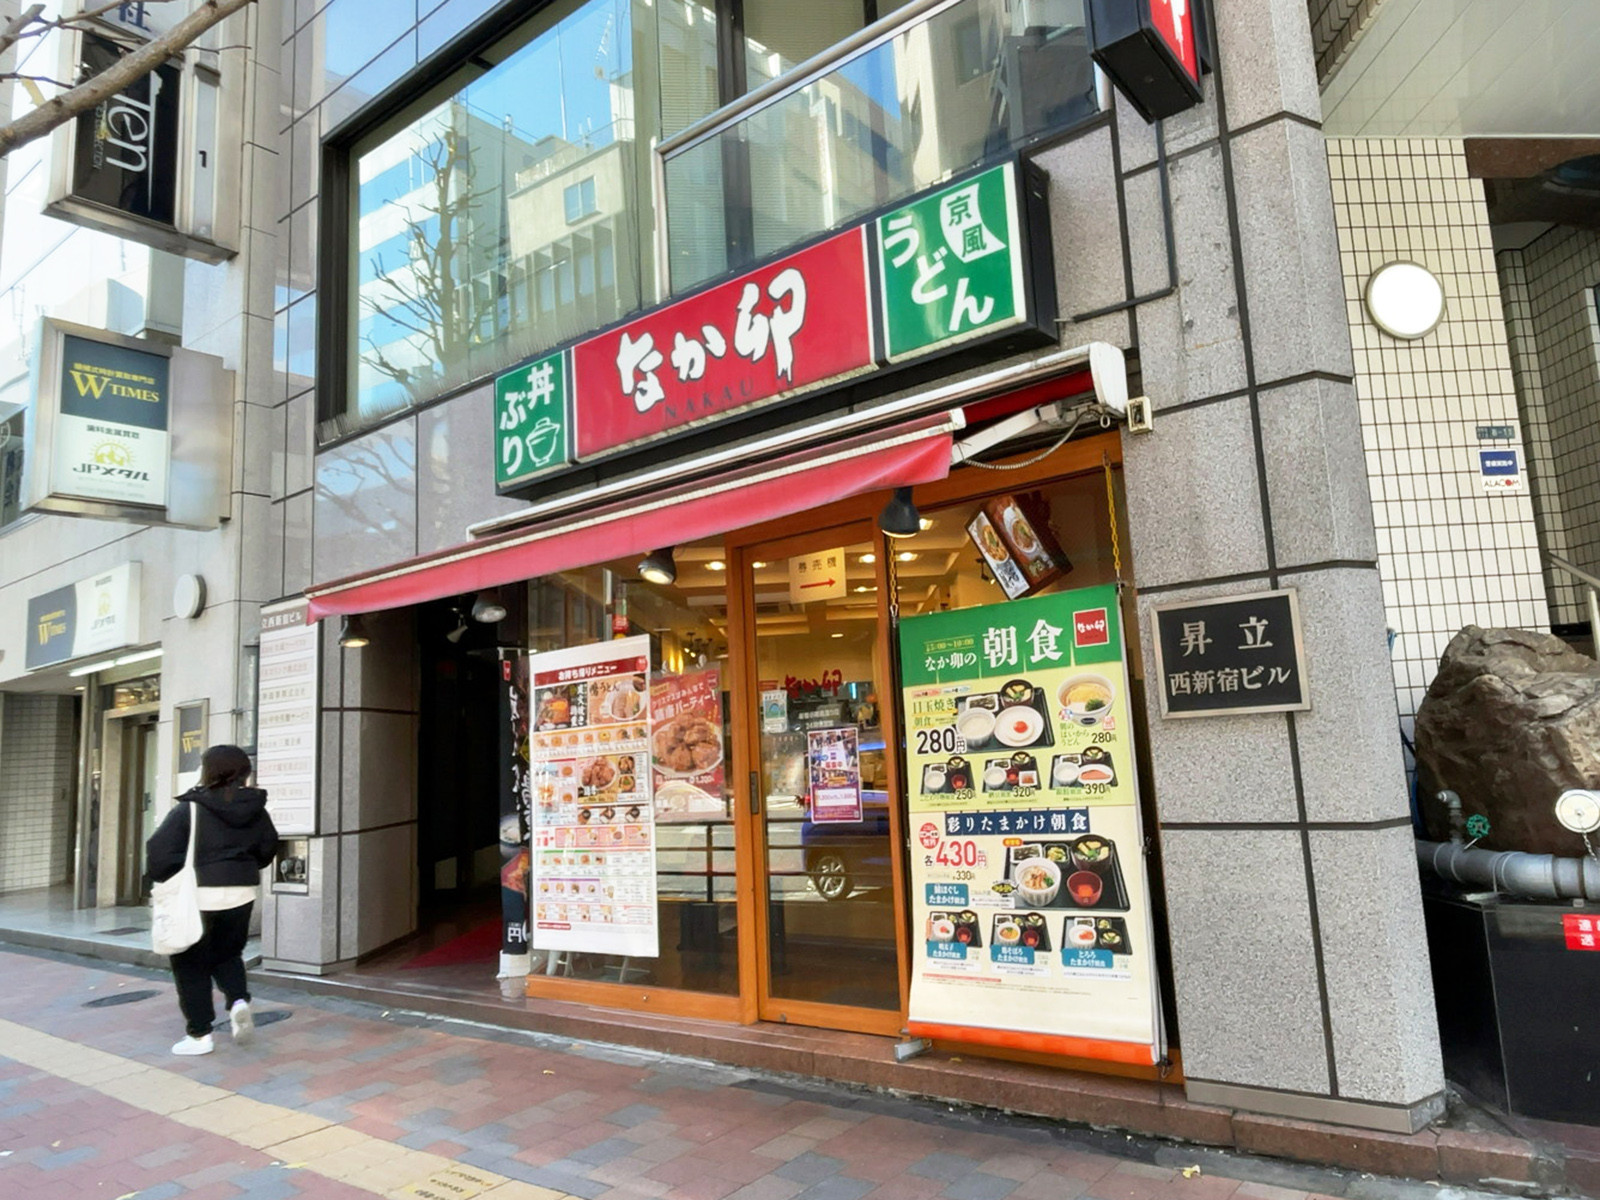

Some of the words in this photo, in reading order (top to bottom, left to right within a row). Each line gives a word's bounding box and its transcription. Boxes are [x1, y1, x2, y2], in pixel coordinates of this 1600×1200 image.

[947, 194, 988, 256] 京風
[883, 212, 995, 332] うどん
[615, 266, 807, 414] なか卯
[664, 378, 757, 422] NAKAU
[72, 462, 150, 483] JPメタル
[924, 651, 978, 672] なか卯の
[982, 618, 1065, 668] 朝食
[1076, 619, 1106, 634] なか卯
[1168, 665, 1292, 697] 西新宿ビル
[947, 812, 1088, 833] 彩りたまかけ朝食
